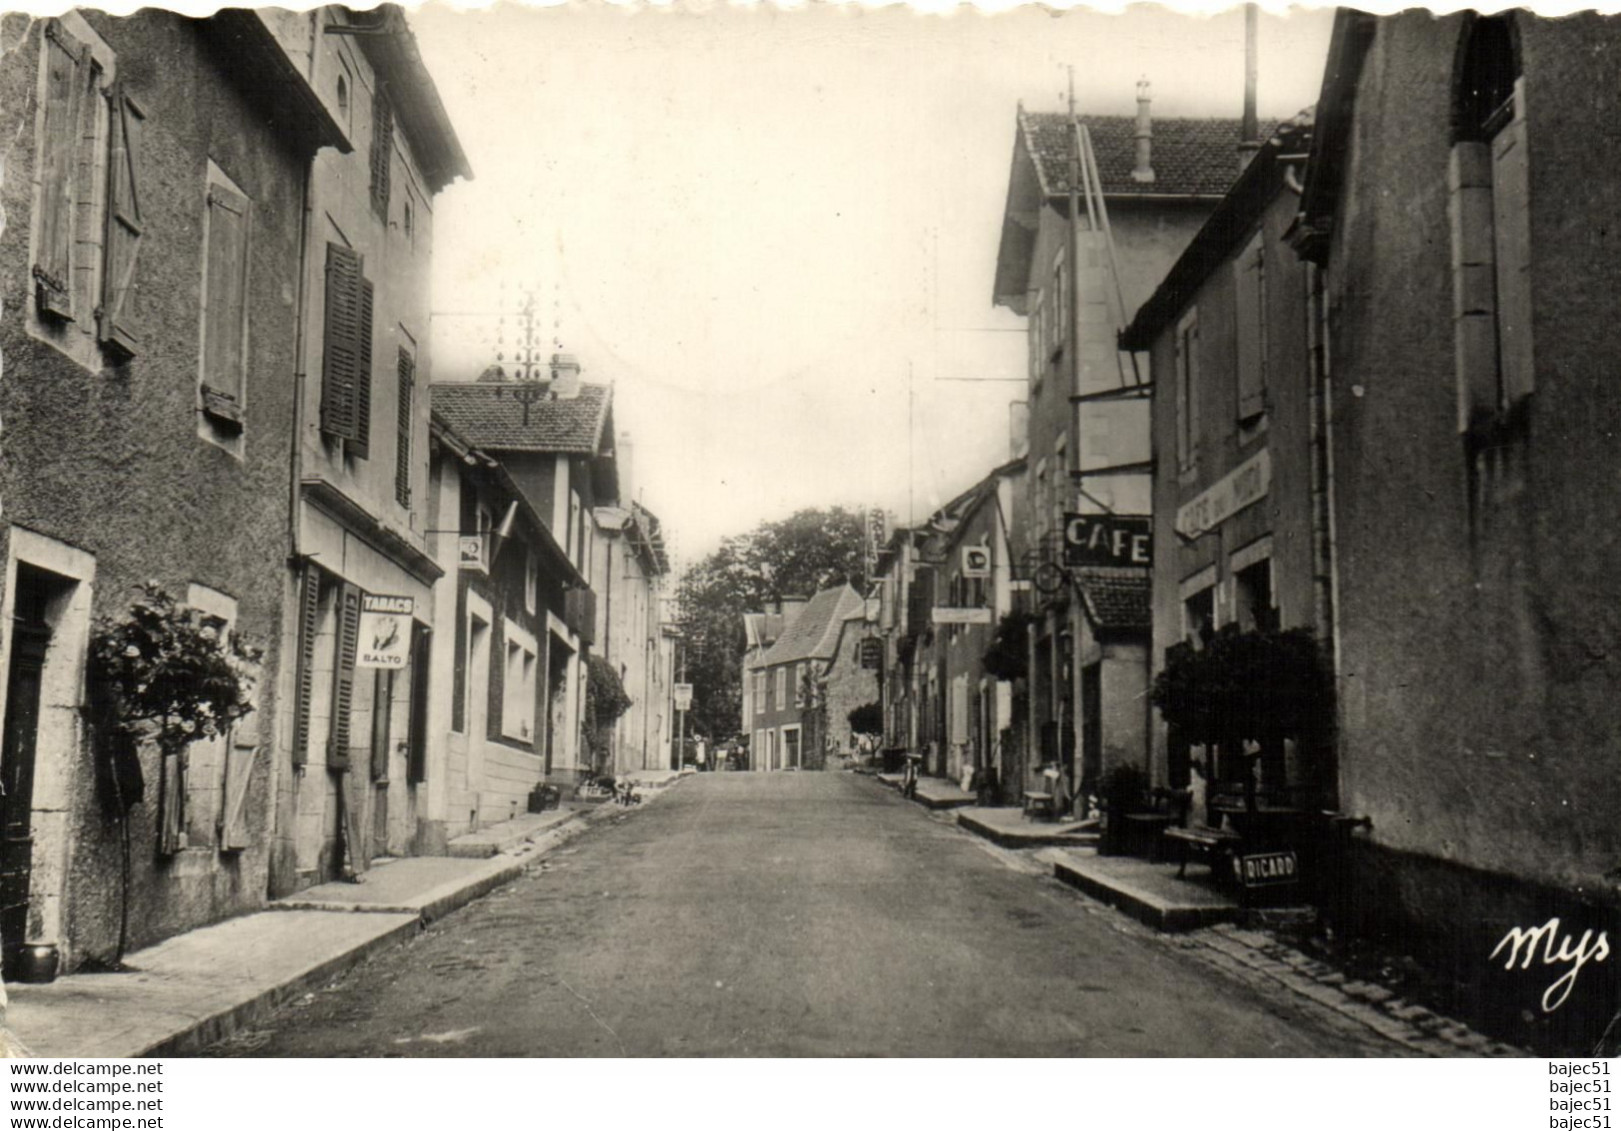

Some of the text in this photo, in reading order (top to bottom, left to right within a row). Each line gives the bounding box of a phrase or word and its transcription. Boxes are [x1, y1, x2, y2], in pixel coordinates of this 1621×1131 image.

[1066, 519, 1150, 562] CAFE
[364, 595, 413, 613] TABACS
[363, 653, 402, 664] BALTO
[1247, 856, 1294, 878] RICARD
